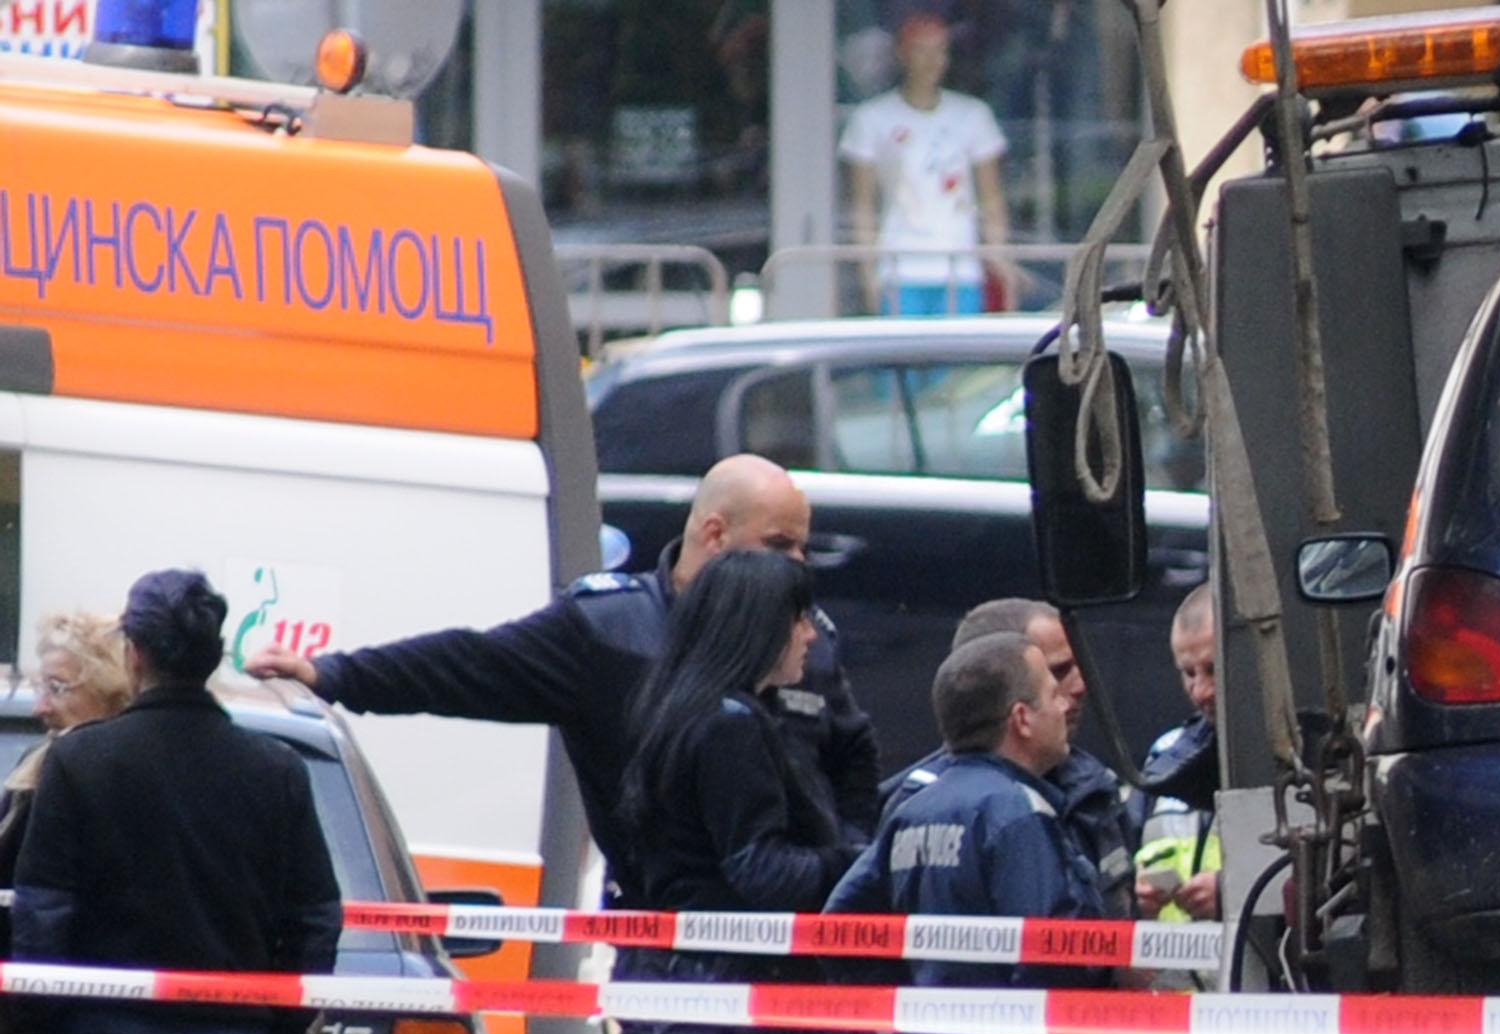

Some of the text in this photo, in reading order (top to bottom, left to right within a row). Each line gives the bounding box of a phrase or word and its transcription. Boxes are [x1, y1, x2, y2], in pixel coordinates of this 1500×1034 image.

[254, 216, 493, 343] ПОМОЩ
[274, 620, 332, 658] 112
[683, 916, 786, 944] ПОЛИЦИЯ
[912, 923, 1017, 952] ПОЛИЦИЯ
